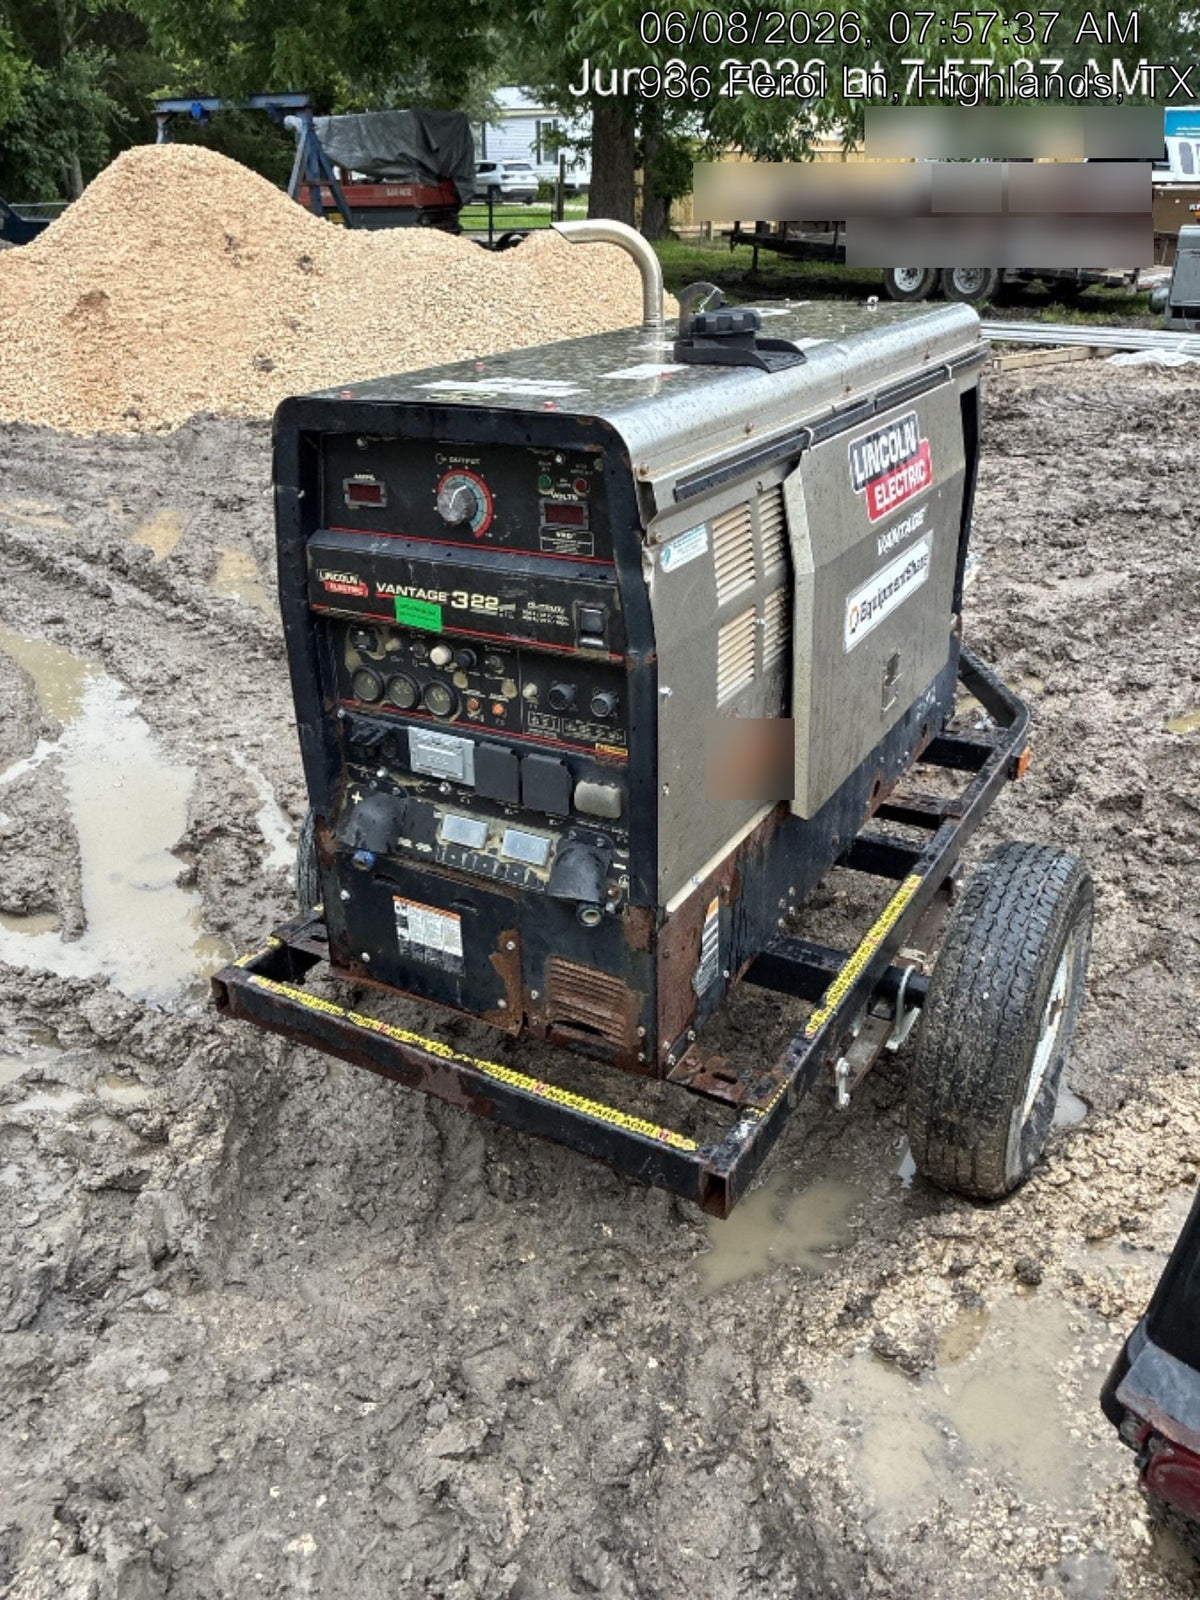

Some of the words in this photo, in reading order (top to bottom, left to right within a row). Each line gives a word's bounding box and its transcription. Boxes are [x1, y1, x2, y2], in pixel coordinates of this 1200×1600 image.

[853, 421, 917, 483] LINCOLN
[874, 458, 926, 511] ELECTRIC
[877, 504, 929, 557] VANTAGE
[320, 570, 359, 584] LINCOLN
[329, 583, 365, 596] ELECTRIC
[375, 582, 449, 602] VANTAGE
[450, 590, 499, 611] 322
